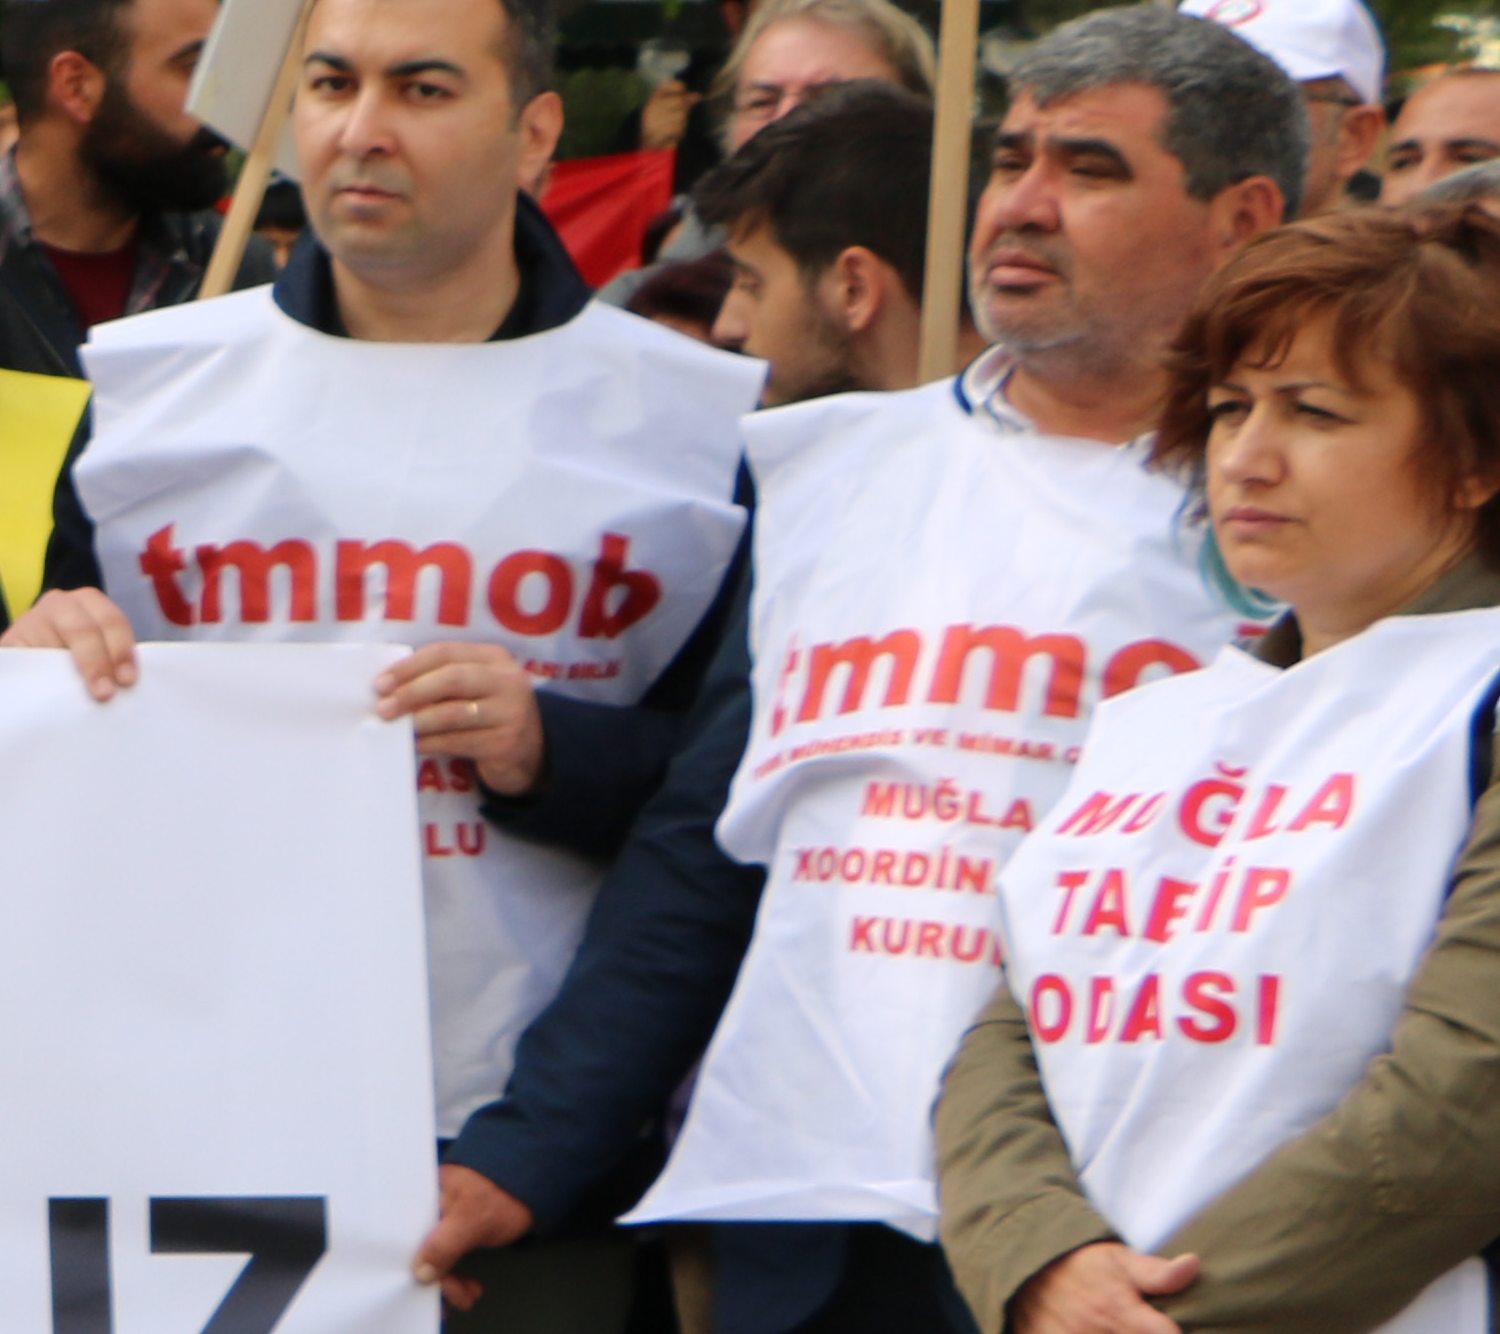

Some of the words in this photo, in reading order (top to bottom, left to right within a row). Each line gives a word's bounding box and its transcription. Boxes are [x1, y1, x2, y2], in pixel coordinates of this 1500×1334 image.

[138, 522, 663, 640] tmmob
[770, 622, 1205, 738] tmmo
[862, 778, 1033, 833] MUĞLA
[792, 845, 998, 894] KOORDİN
